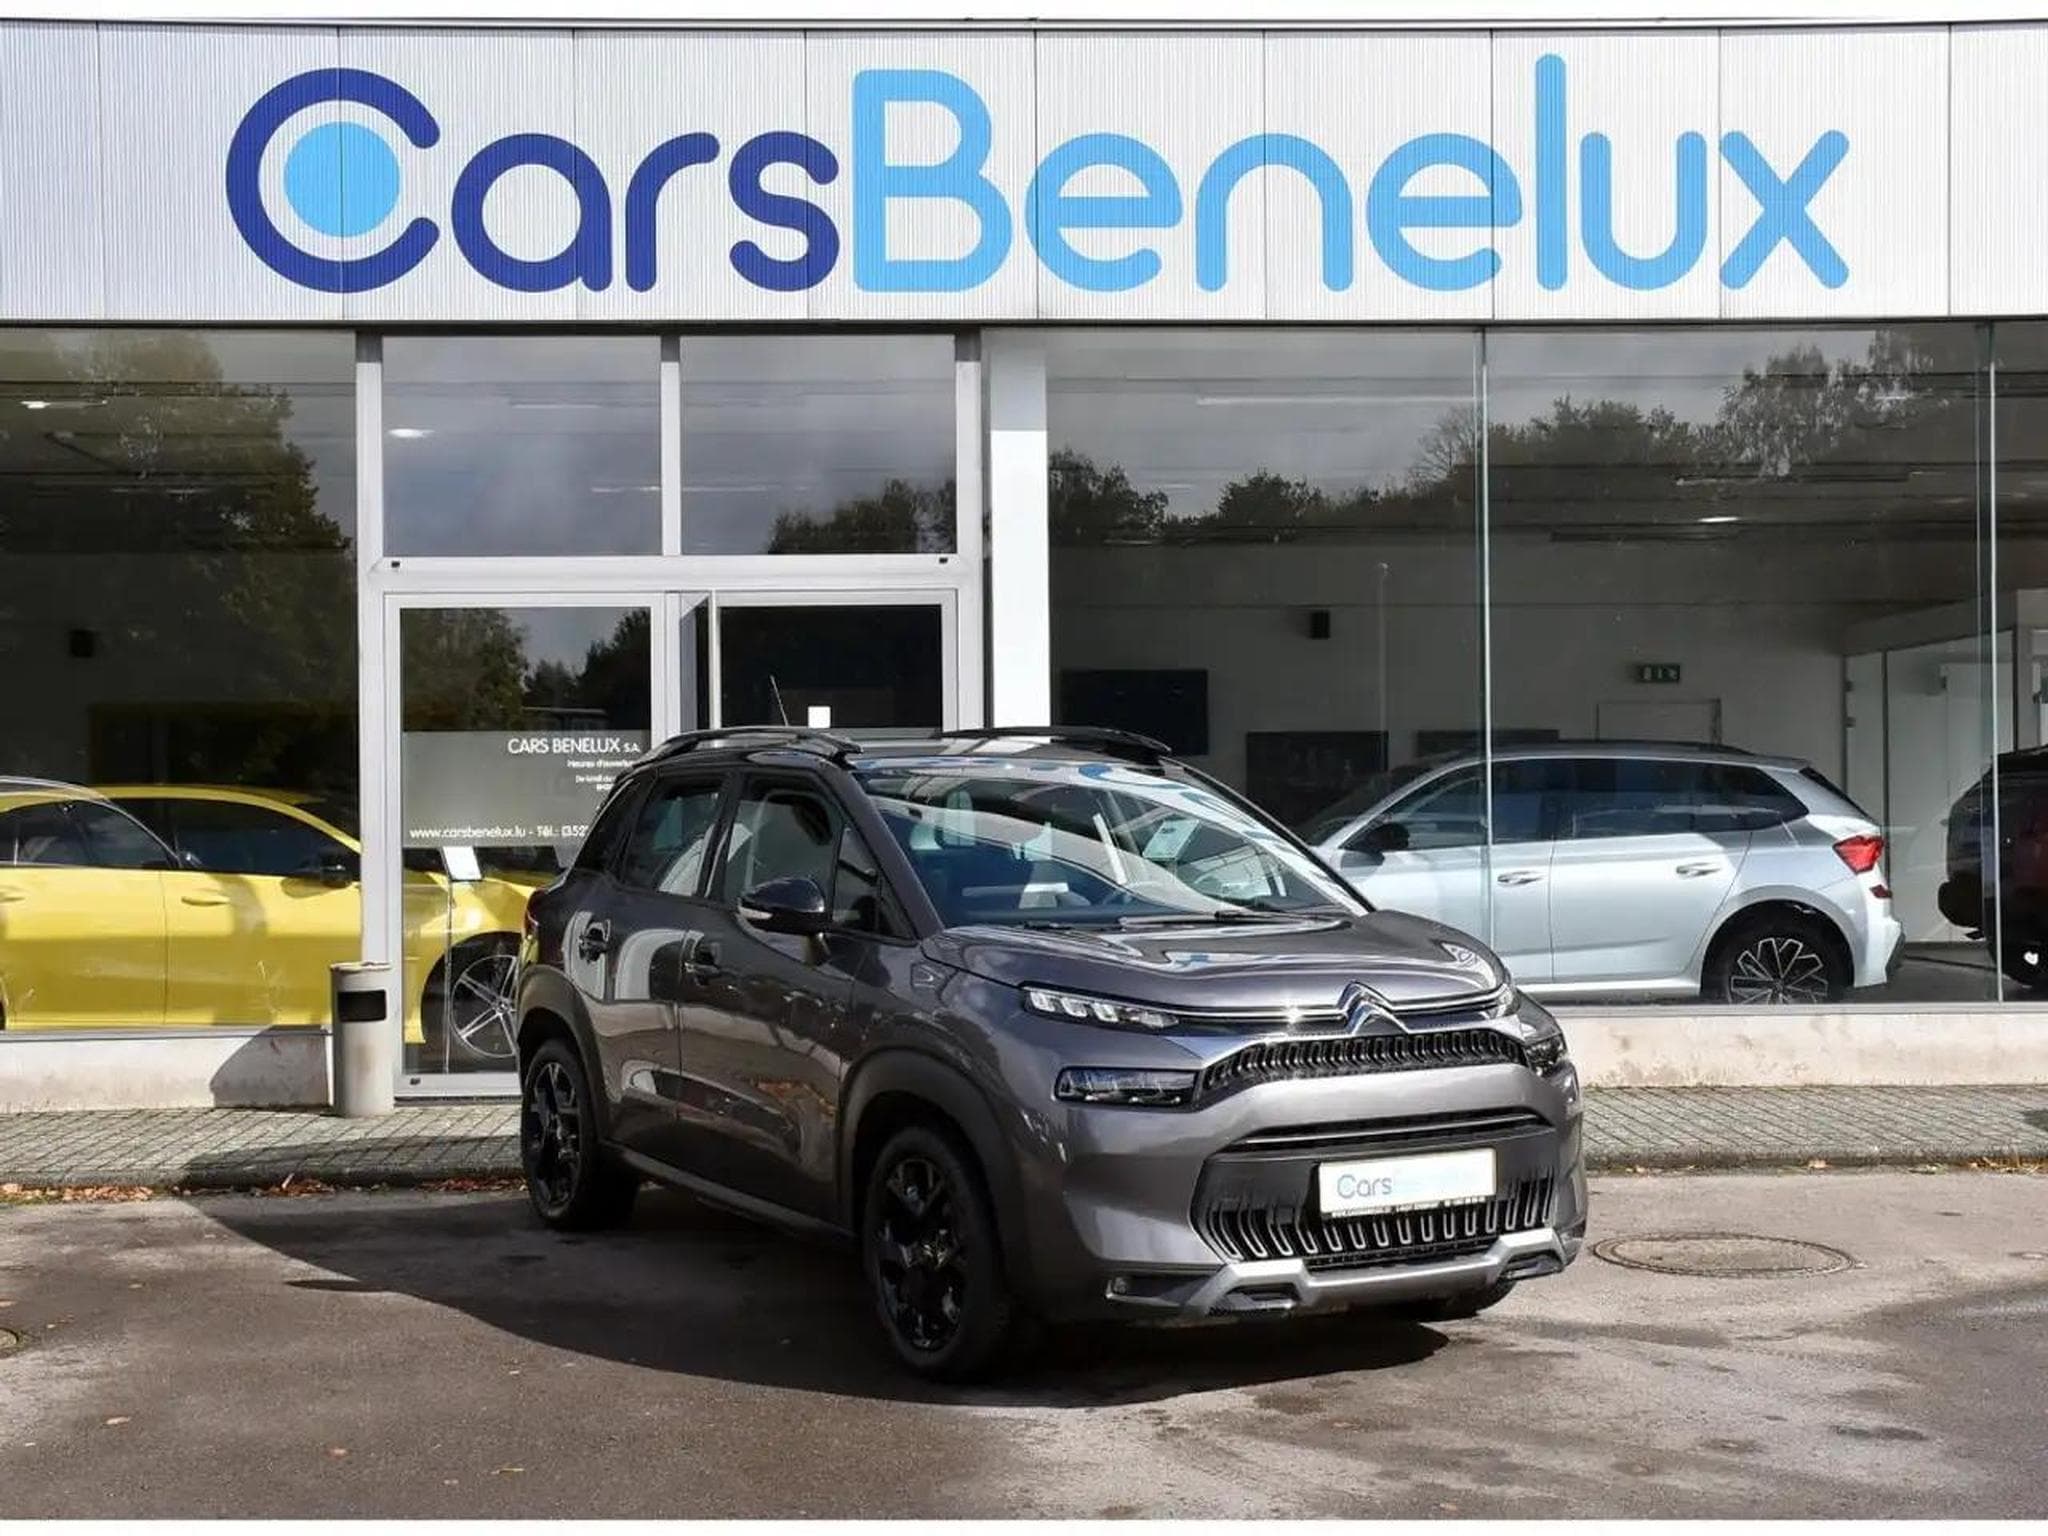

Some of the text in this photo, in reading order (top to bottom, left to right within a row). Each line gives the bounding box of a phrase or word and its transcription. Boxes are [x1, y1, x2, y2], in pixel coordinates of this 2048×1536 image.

[226, 54, 1848, 293] CarsBenelux
[508, 738, 549, 754] CARS
[553, 738, 620, 753] BENELUX
[409, 825, 526, 839] www.carsbenelux.lu
